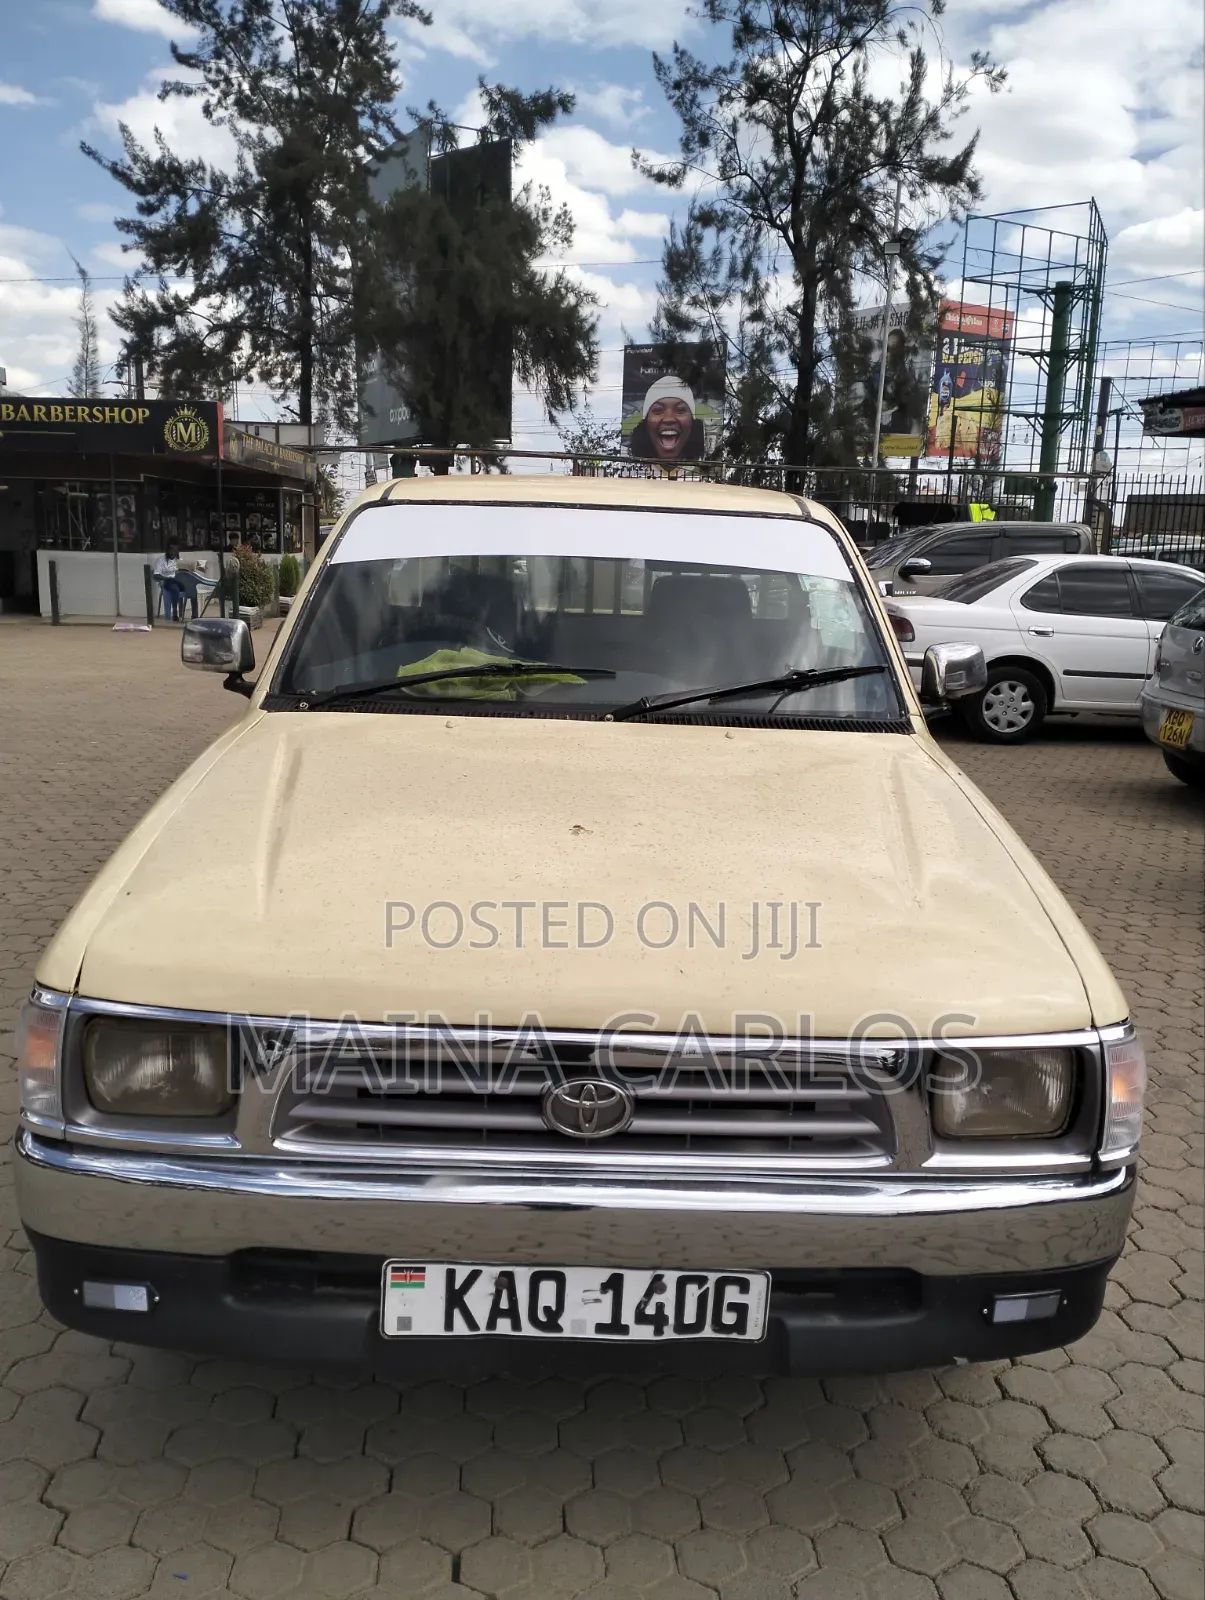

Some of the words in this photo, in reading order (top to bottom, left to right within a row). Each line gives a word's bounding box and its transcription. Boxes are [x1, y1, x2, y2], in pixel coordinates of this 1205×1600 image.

[0, 403, 151, 425] BARBERSHOP
[1162, 725, 1187, 745] 126N
[443, 1267, 567, 1334] KAQ
[594, 1272, 751, 1337] 140G
